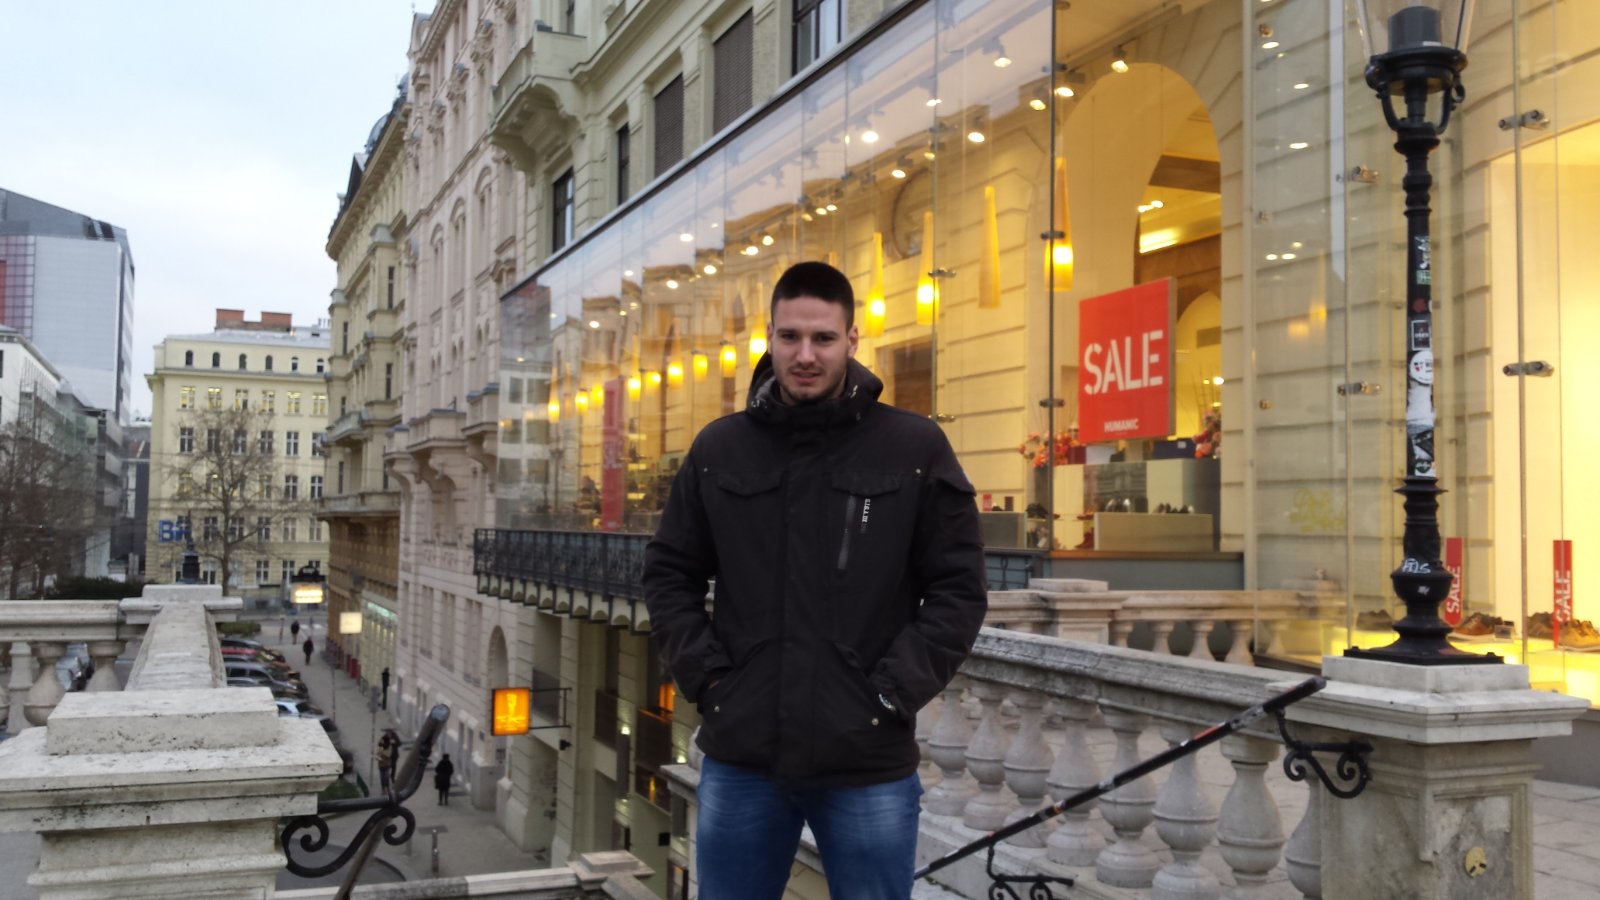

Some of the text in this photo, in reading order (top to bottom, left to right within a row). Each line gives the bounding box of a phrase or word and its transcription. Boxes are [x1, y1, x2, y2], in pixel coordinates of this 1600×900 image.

[1084, 329, 1163, 395] SALE
[1446, 565, 1461, 614] SALE
[1555, 570, 1571, 622] SALE
